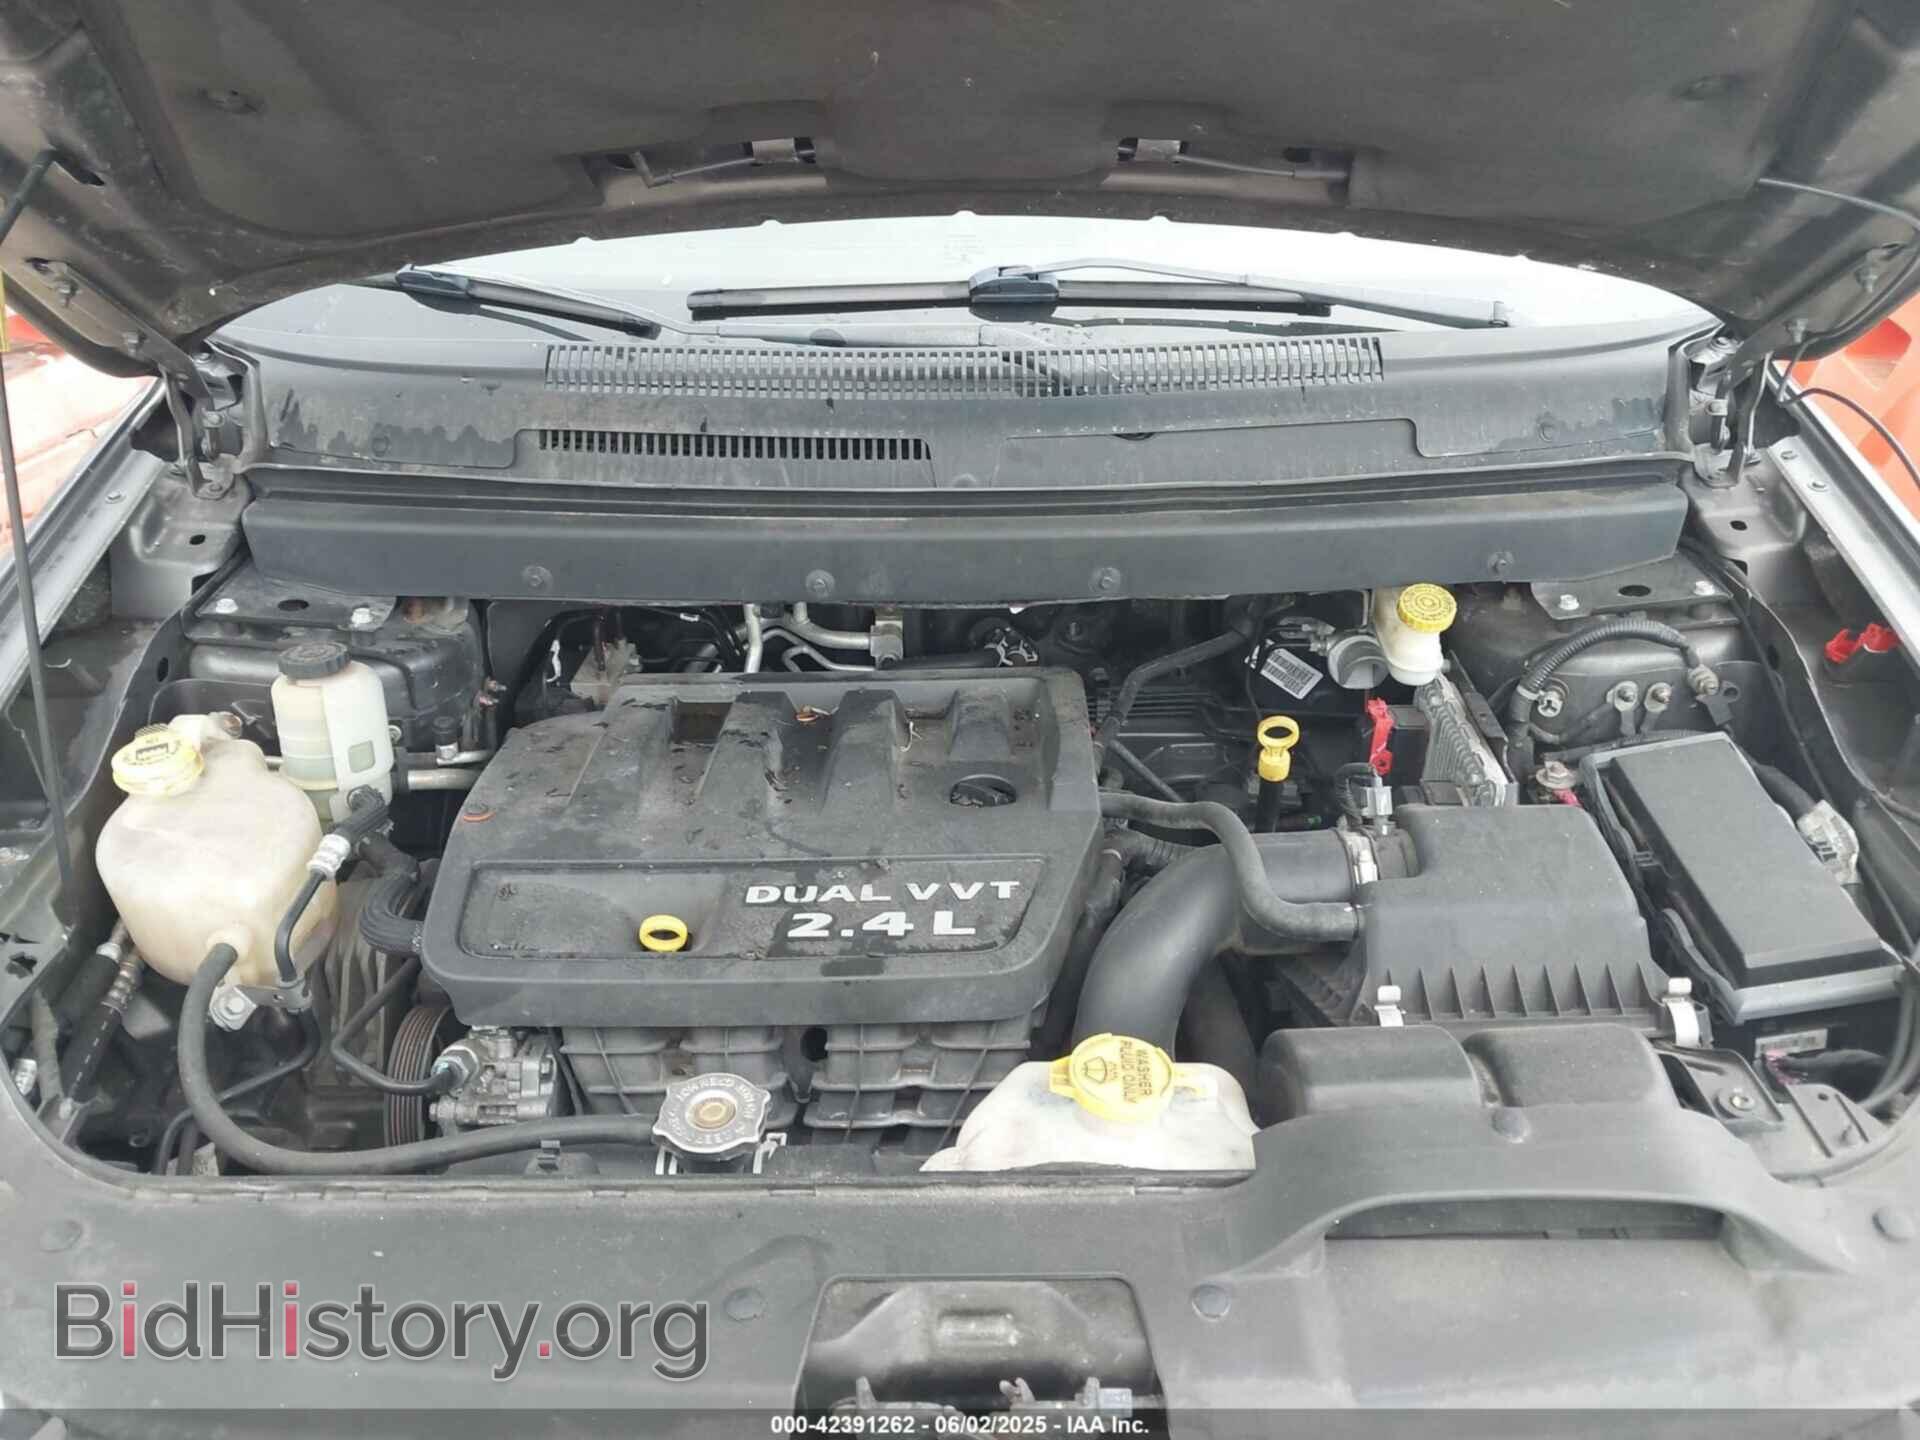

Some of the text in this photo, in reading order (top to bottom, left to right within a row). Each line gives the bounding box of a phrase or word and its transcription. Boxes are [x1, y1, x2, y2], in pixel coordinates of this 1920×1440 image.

[745, 880, 1021, 904] DUAL VVT
[1120, 1039, 1138, 1104] FLUID ONLY
[1136, 1049, 1153, 1097] WASHER
